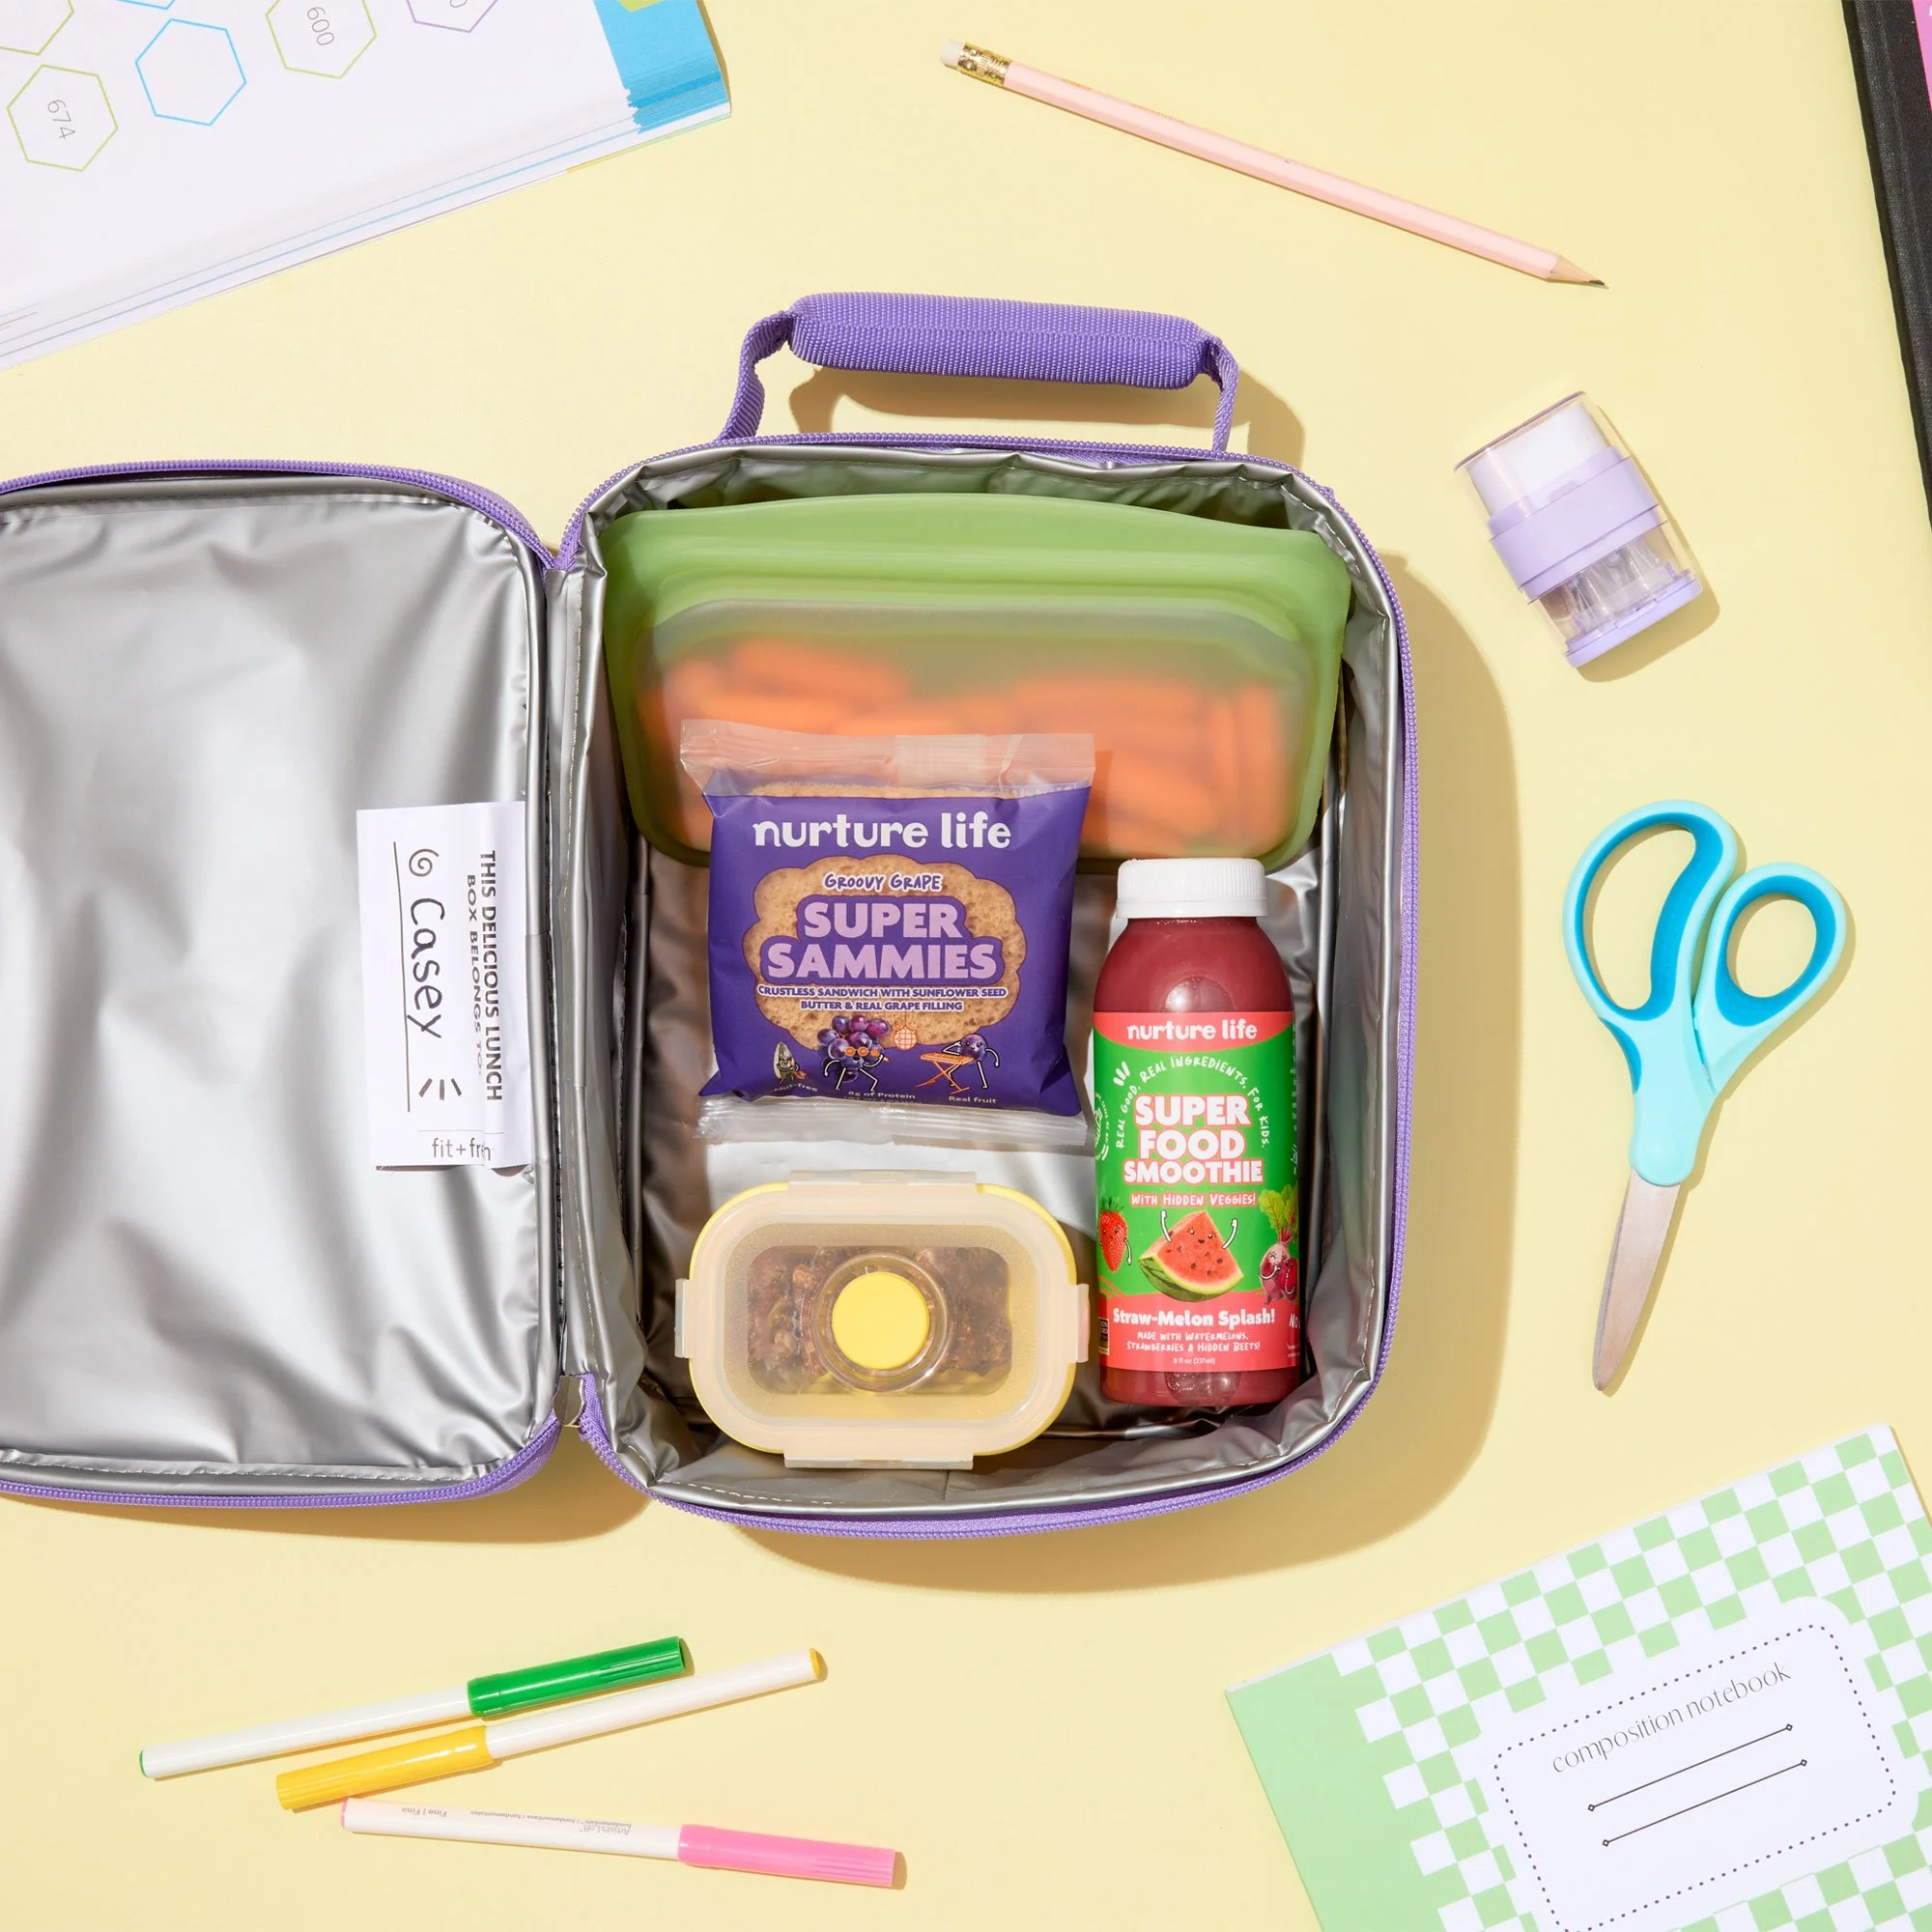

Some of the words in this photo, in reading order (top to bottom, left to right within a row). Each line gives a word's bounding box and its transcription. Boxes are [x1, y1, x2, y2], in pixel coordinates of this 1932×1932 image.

[306, 6, 335, 46] 600
[46, 99, 77, 140] 674
[753, 814, 928, 848] nurture
[941, 810, 1011, 848] life
[480, 850, 496, 898] THIS
[824, 873, 884, 891] GROOVY
[891, 874, 943, 891] GRAPE
[468, 874, 477, 923] BOX
[804, 901, 963, 938] SUPER
[407, 897, 445, 1038] Casey
[482, 906, 499, 1018] DELICIOUS
[768, 943, 997, 979] SAMMIES
[469, 931, 482, 1034] BELONGS
[758, 985, 815, 997] CRUSTLESS
[817, 988, 877, 998] SANDWICH
[880, 988, 910, 998] WITH
[912, 988, 979, 998] SUNFLOWER
[981, 987, 1008, 997] SEED
[801, 1001, 842, 1009] BUTTER
[844, 1002, 853, 1010] &
[855, 1002, 882, 1010] REAL
[884, 1002, 921, 1010] GRAPE
[923, 1002, 962, 1010] FILLING
[1127, 1020, 1217, 1040] nurture
[1222, 1018, 1258, 1040] life
[485, 1026, 502, 1100] LUNCH
[1116, 1120, 1125, 1149] REAL
[1140, 1061, 1167, 1084] REAL
[1135, 1095, 1251, 1126] SUPER
[432, 1138, 453, 1158] fit
[1140, 1129, 1245, 1160] FOOD
[1123, 1160, 1264, 1184] SMOOTHIE
[1131, 1194, 1158, 1206] WITH
[1113, 1307, 1214, 1326] Straw-Melon
[1218, 1308, 1275, 1330] Splash!
[1126, 1340, 1184, 1352] STRAWBERRIES
[1233, 1341, 1261, 1352] BEETS!
[1137, 1331, 1157, 1341] MADE
[1160, 1332, 1181, 1341] WITH
[1552, 1708, 1684, 1773] composition
[1686, 1662, 1791, 1719] notebook
[402, 1807, 420, 1816] Fina
